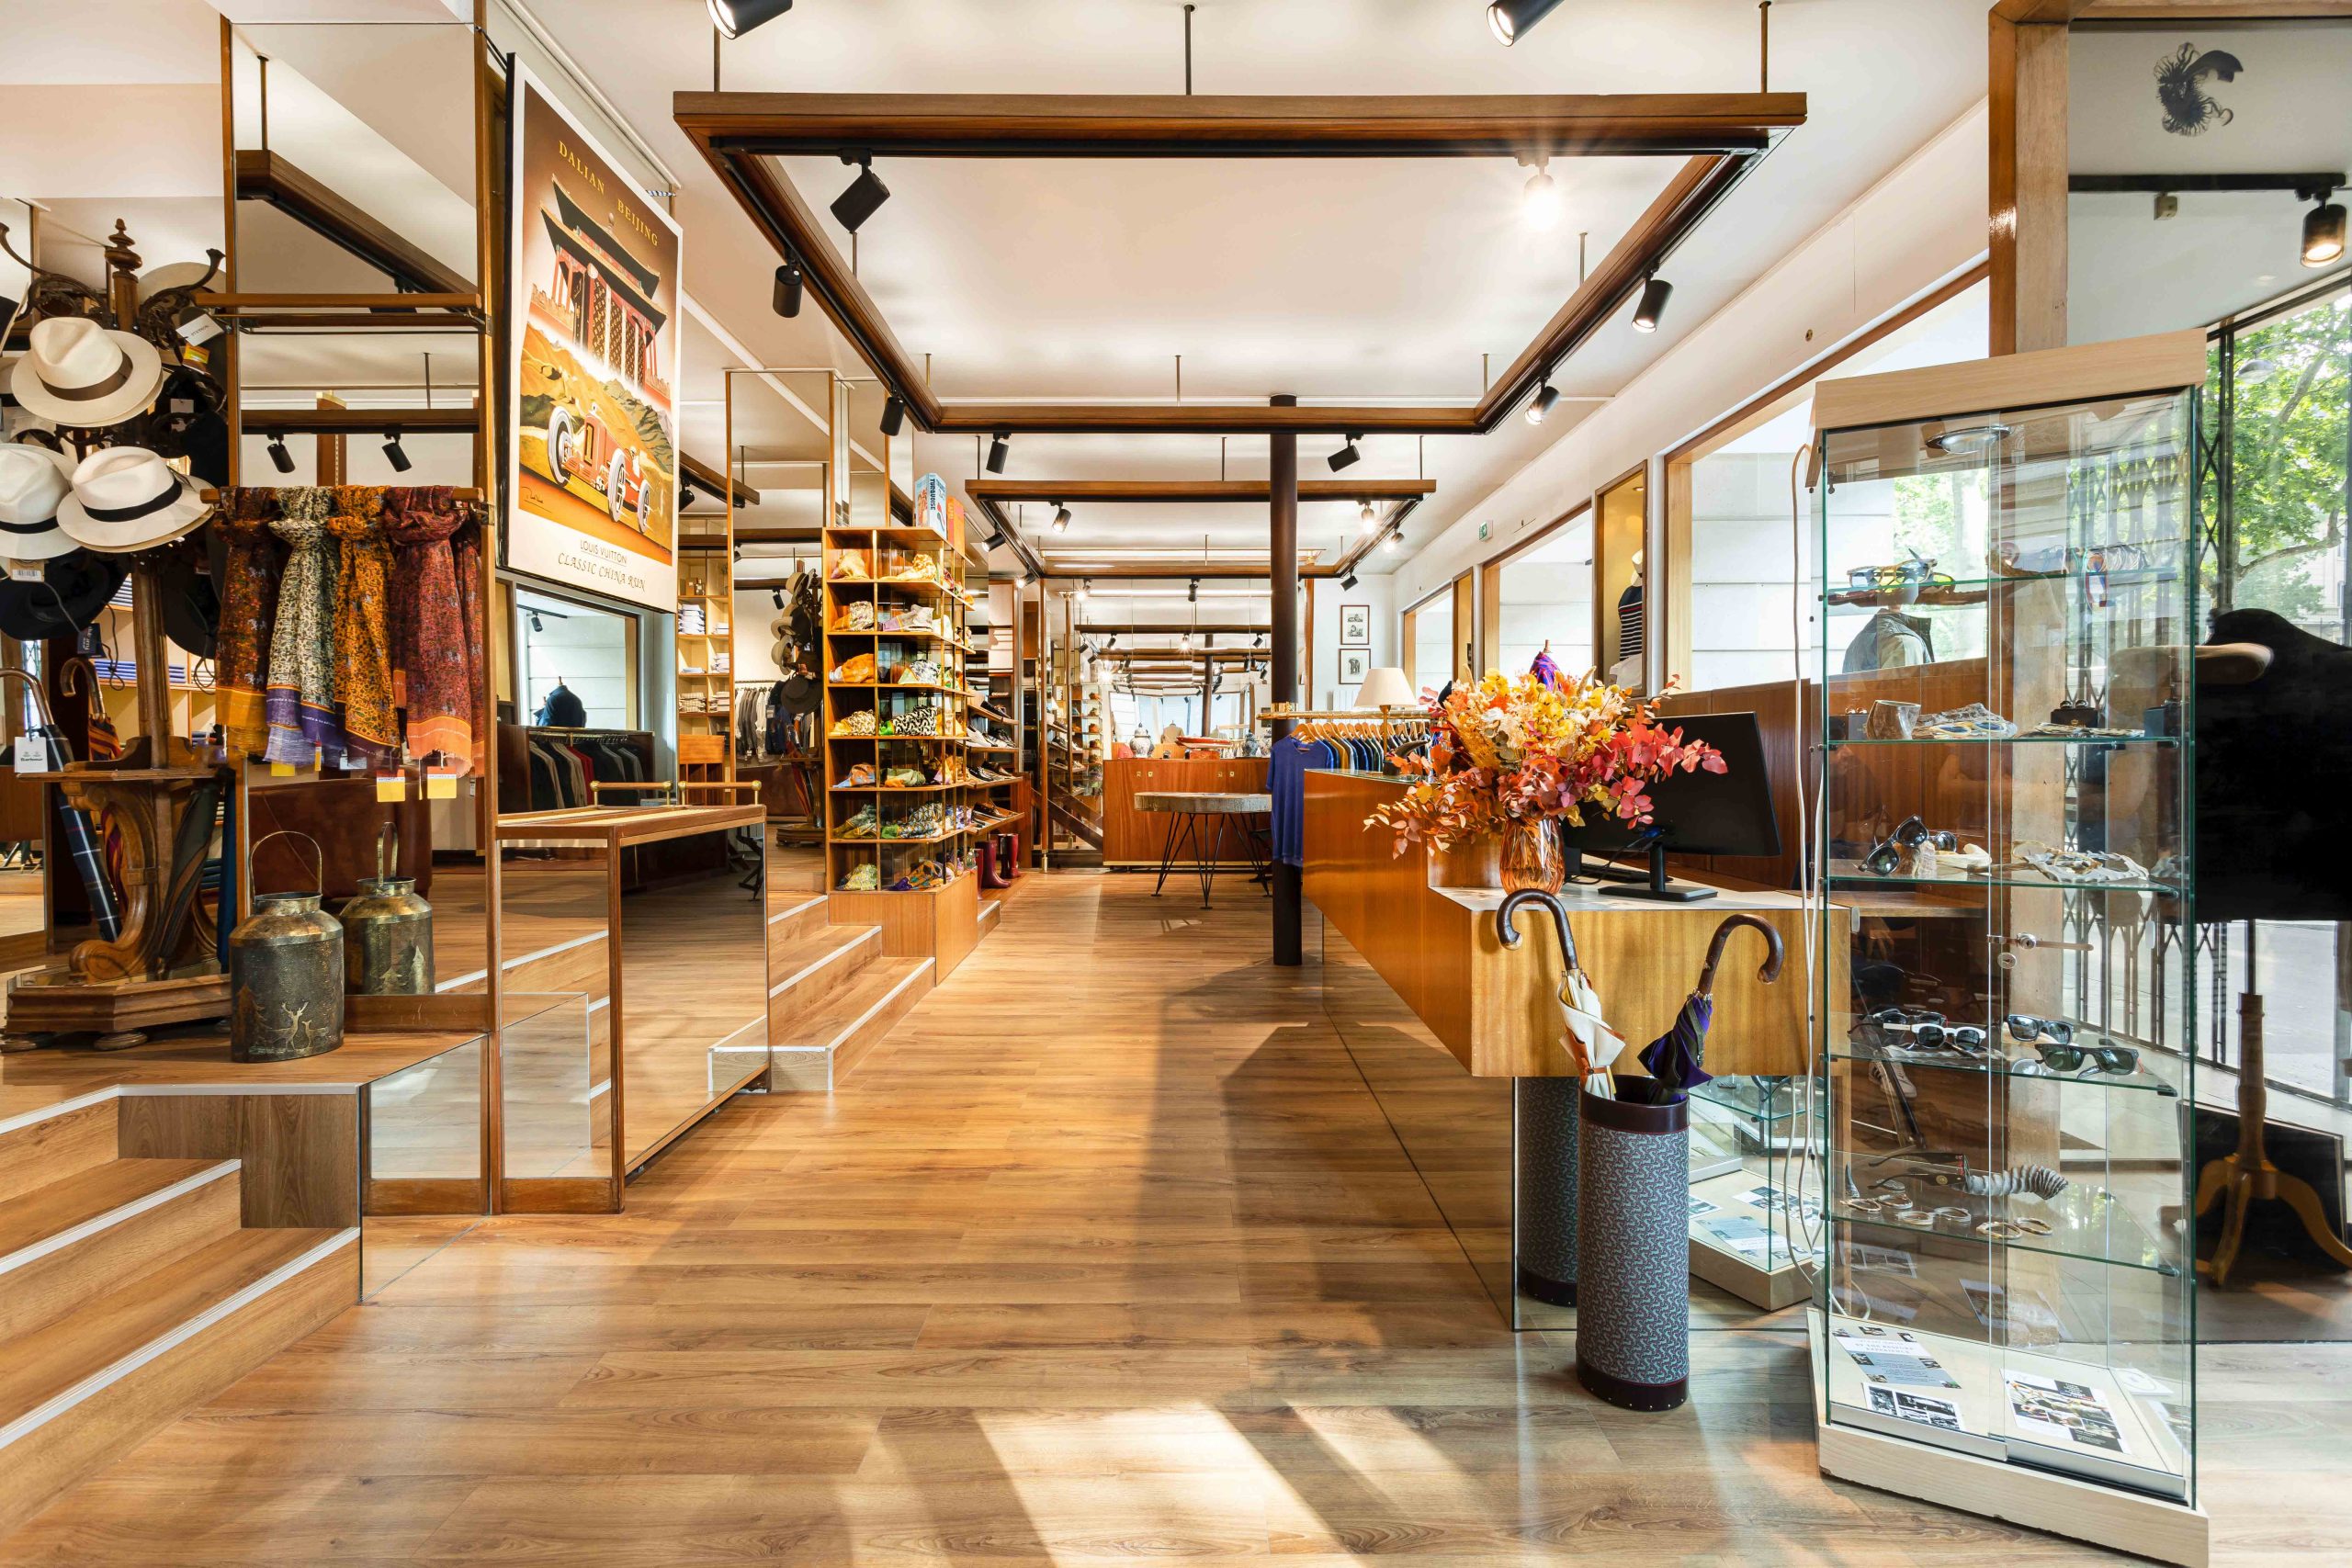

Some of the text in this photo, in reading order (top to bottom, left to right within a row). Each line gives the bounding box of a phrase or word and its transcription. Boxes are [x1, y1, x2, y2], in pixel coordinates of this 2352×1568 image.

[559, 140, 658, 246] DALIAN BEIJING
[580, 539, 628, 564] LOUIS VUITTON
[558, 552, 646, 592] CLASSIC CHINA RUN
